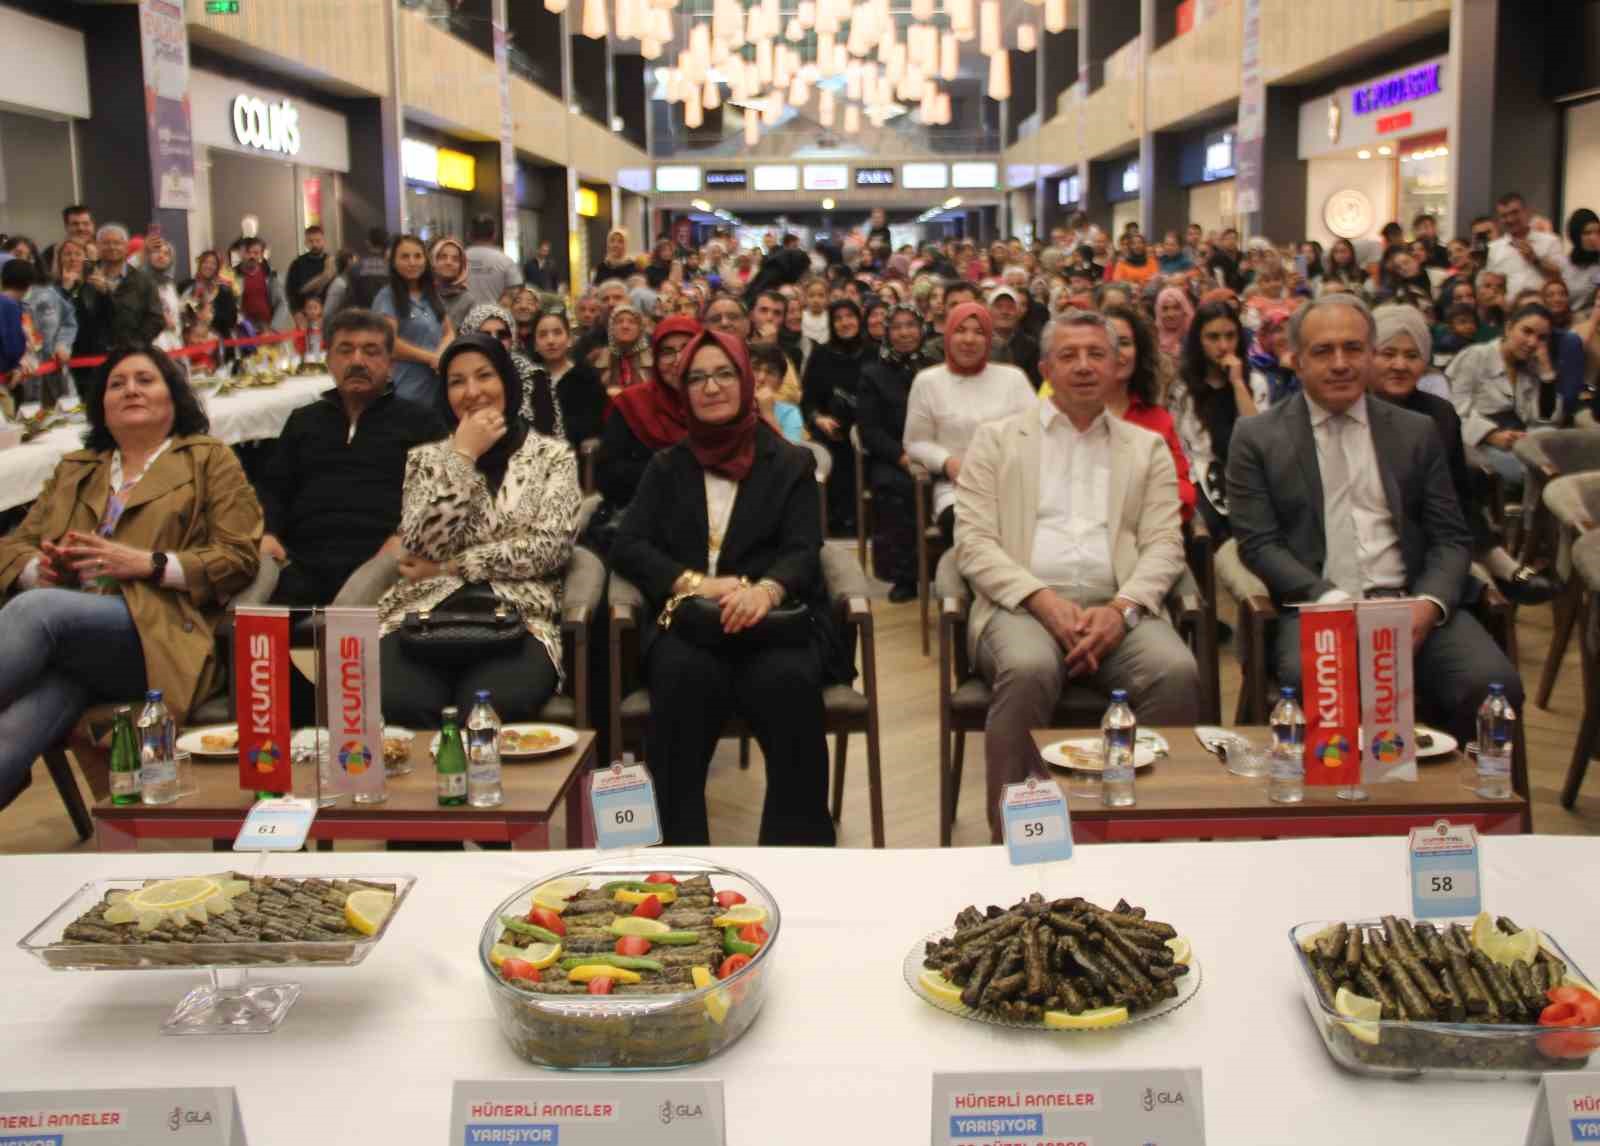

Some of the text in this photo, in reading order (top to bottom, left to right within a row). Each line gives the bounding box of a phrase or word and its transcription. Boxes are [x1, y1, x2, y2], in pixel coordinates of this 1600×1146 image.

[250, 633, 272, 734] KUMS
[1314, 628, 1339, 728] KUMS
[615, 809, 634, 825] 60
[257, 824, 279, 834] 61
[1024, 822, 1044, 838] 59
[1431, 876, 1453, 892] 58
[1024, 1093, 1095, 1107] ANNELER
[1157, 1091, 1185, 1104] GLA
[185, 1111, 213, 1123] GLA
[542, 1104, 614, 1117] ANNELER
[675, 1104, 703, 1116] GLA
[47, 1112, 121, 1127] ANNELER
